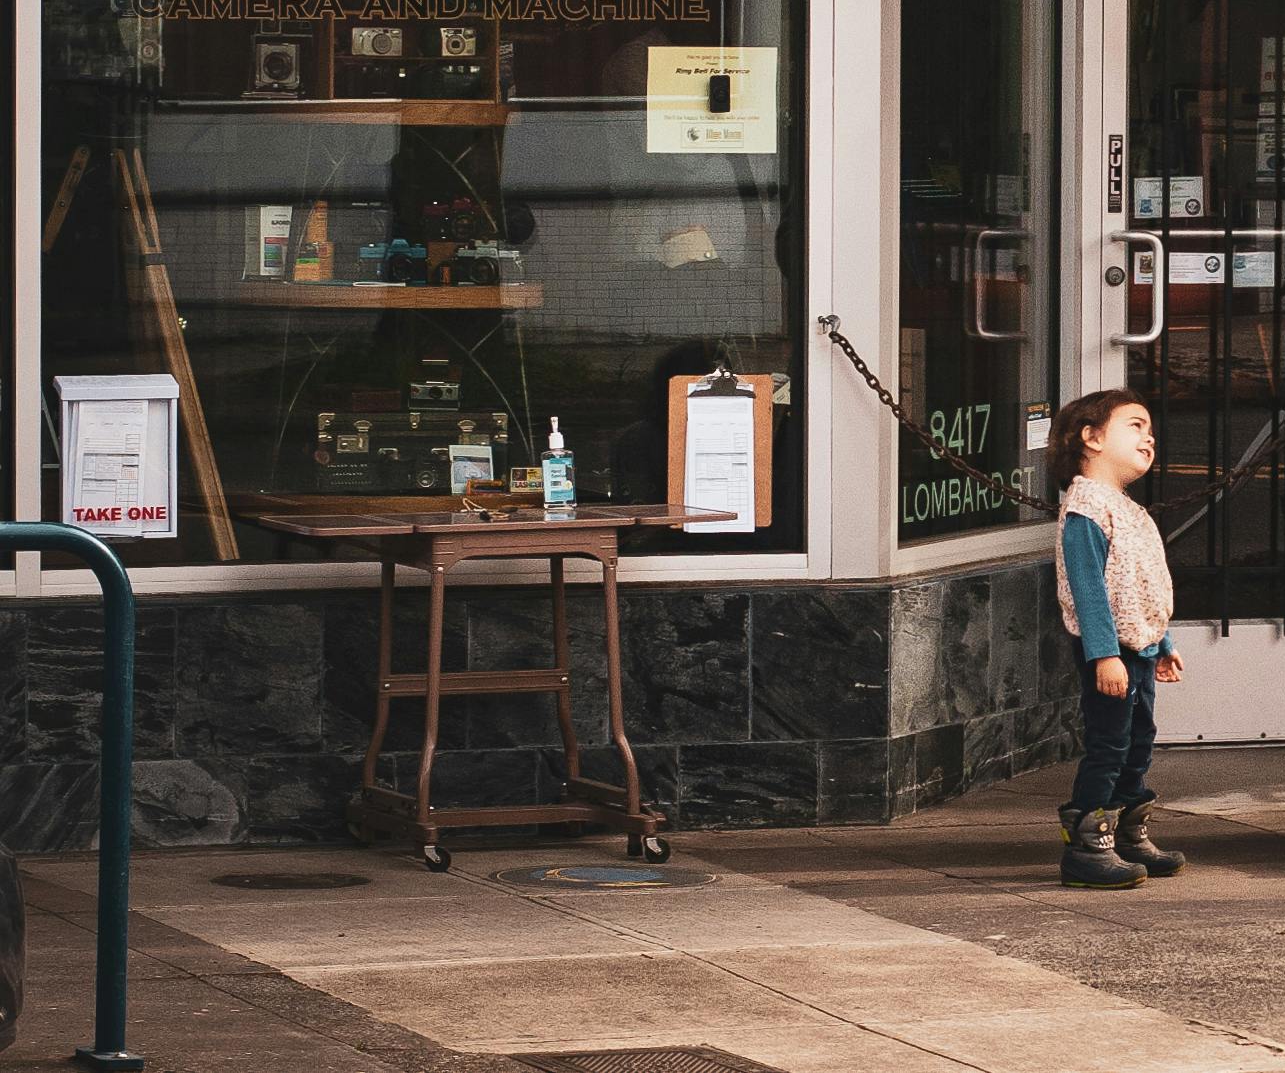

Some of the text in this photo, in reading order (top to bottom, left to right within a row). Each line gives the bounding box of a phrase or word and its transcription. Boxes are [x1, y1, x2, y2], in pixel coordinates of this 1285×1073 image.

[675, 67, 692, 75] Ring
[1109, 140, 1122, 196] PULL
[929, 403, 991, 460] 8417
[72, 506, 168, 522] TAKE ONE
[902, 466, 1036, 524] LOMBARD ST
